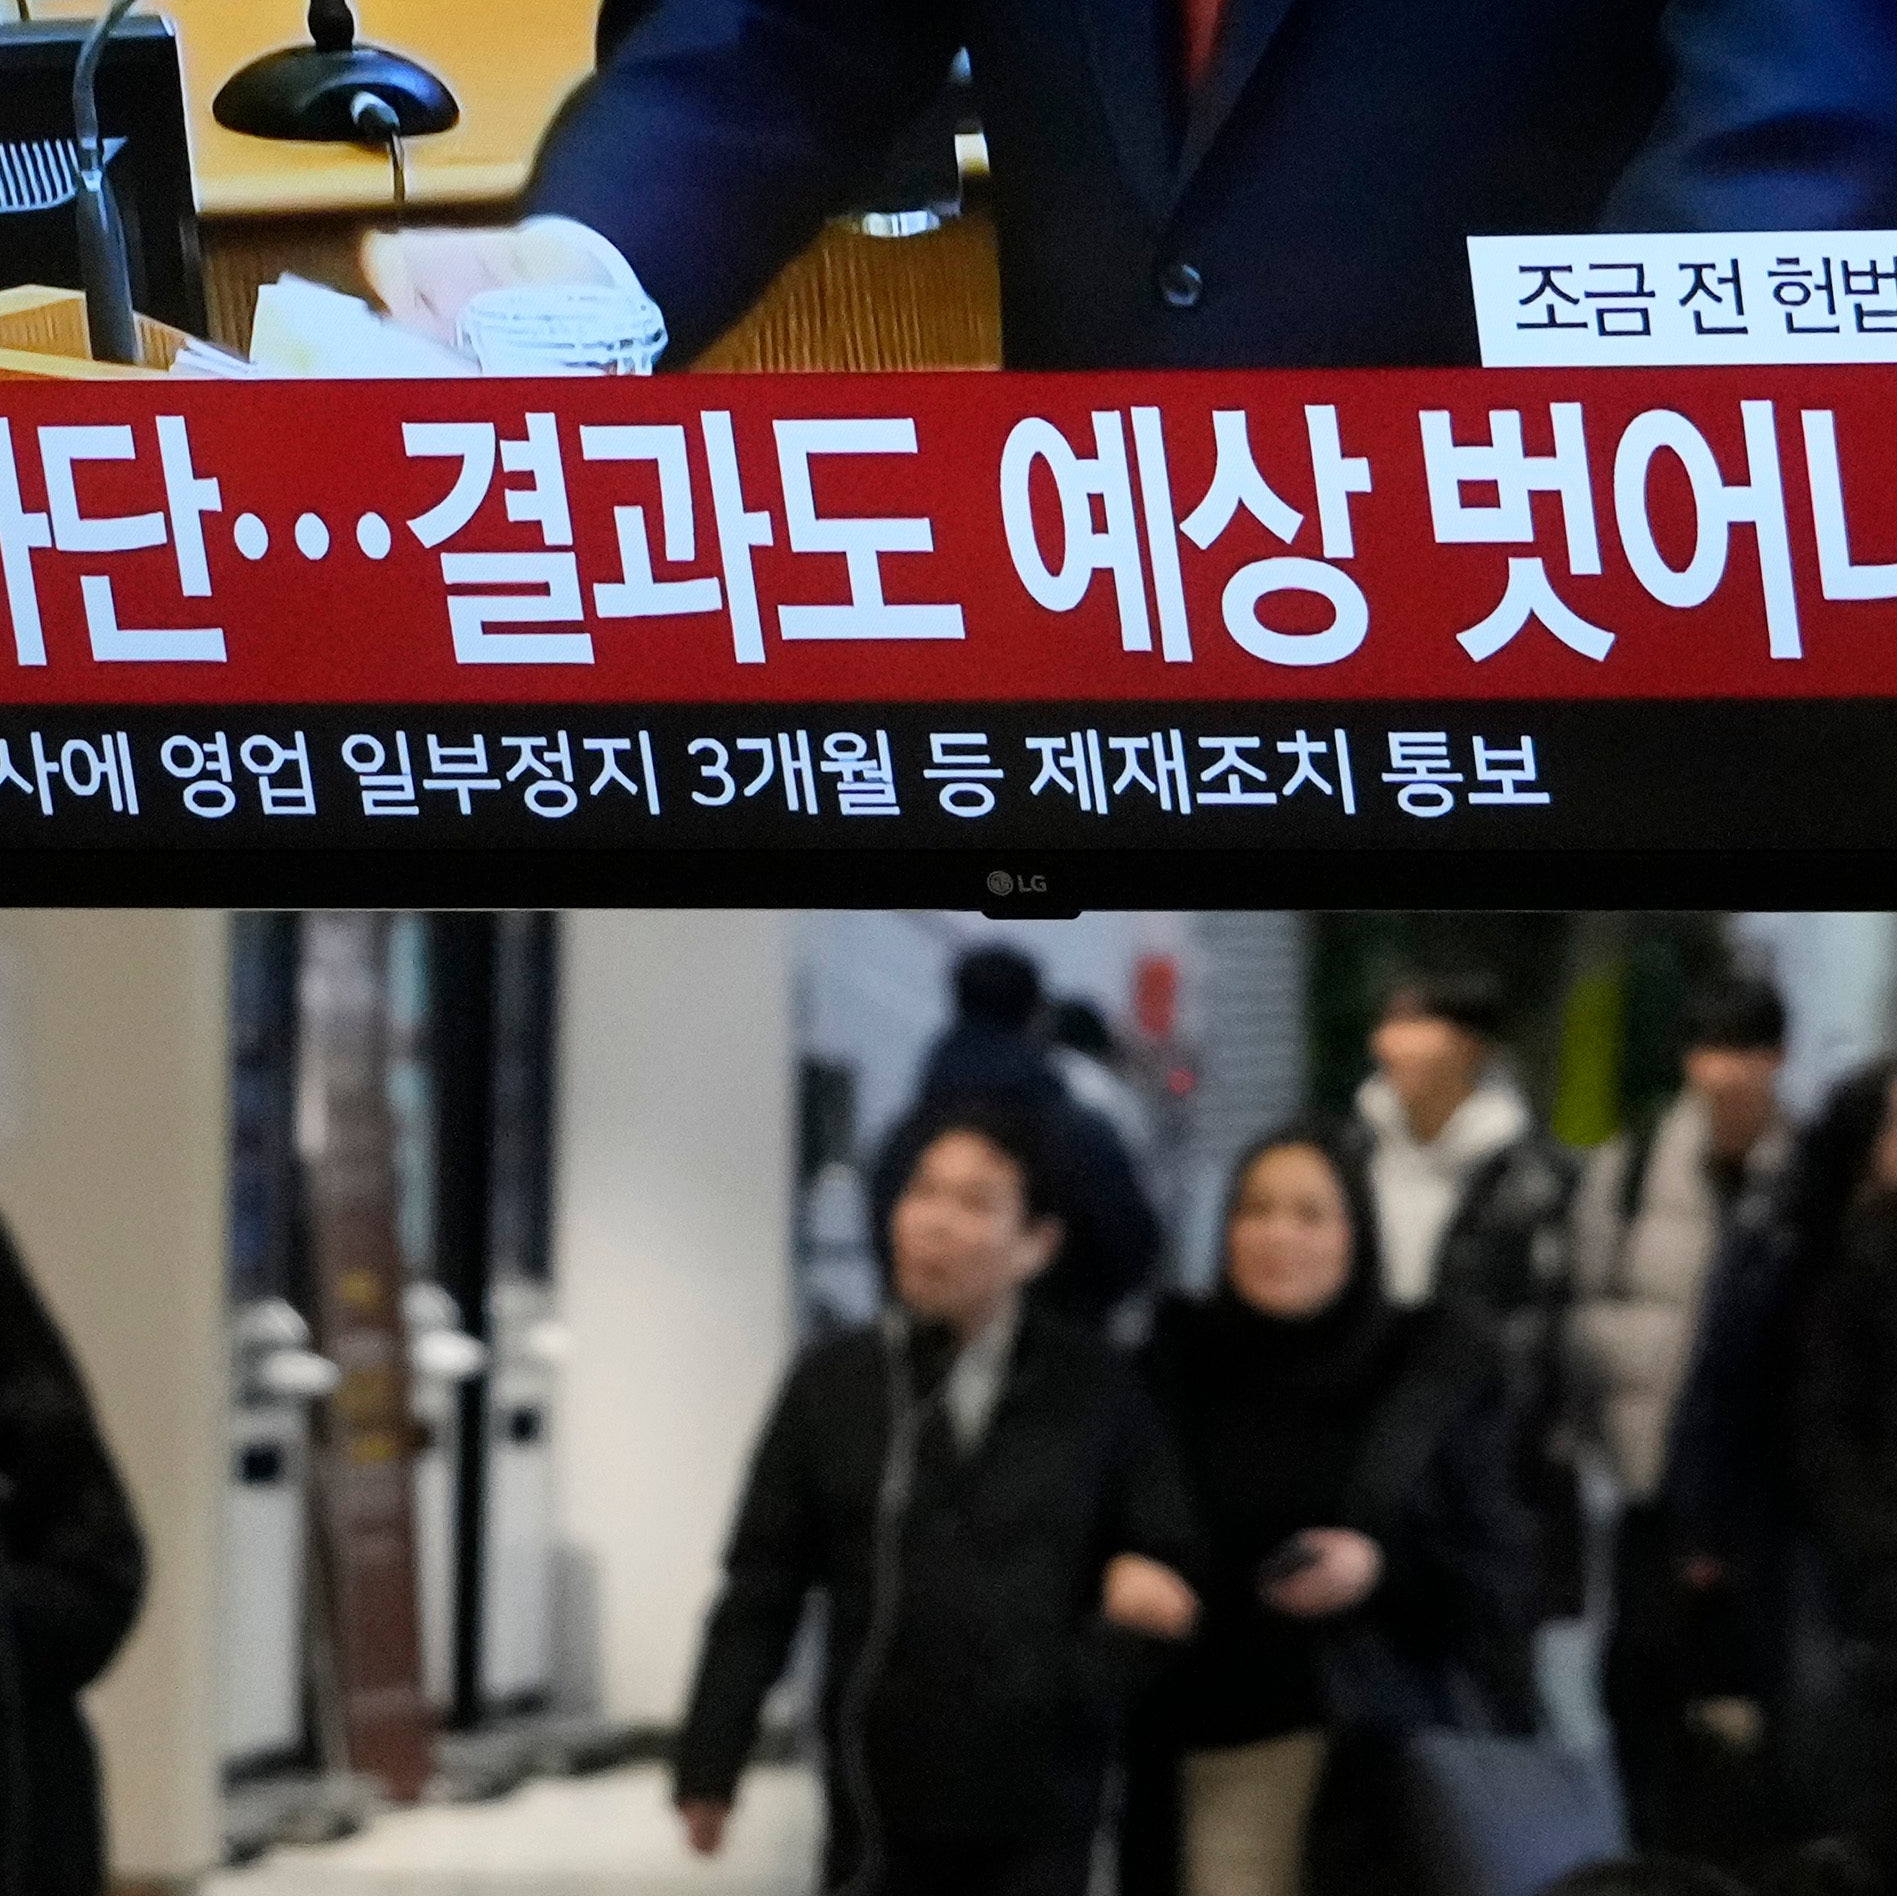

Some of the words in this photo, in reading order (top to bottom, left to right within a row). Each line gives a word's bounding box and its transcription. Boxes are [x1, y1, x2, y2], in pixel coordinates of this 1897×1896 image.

[1515, 261, 1657, 338] 조금
[1677, 257, 1750, 336] 전
[998, 403, 1373, 667] 예상
[159, 729, 318, 820] 영업
[340, 728, 662, 820] 일부정지
[686, 728, 902, 817] 3개월
[921, 731, 1006, 819] 등
[1024, 727, 1357, 816] 제재조치
[1380, 730, 1552, 819] 통보
[1016, 873, 1048, 894] LG
